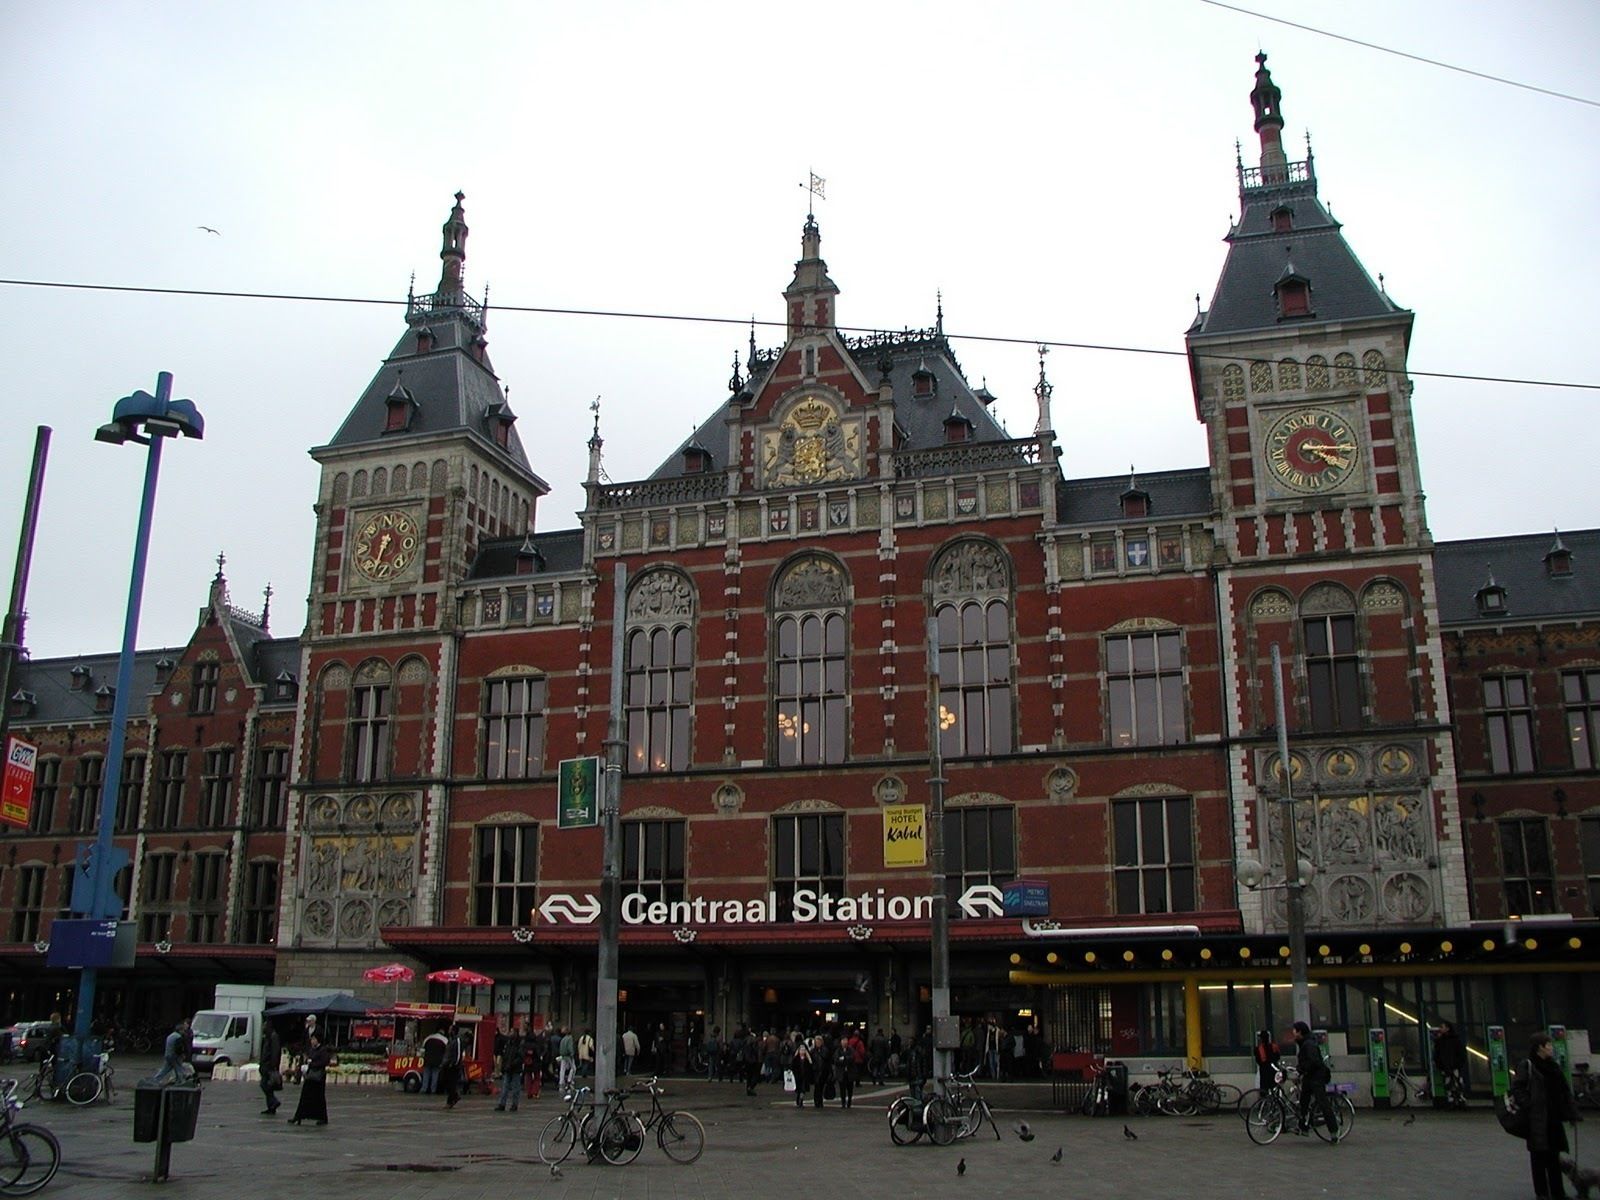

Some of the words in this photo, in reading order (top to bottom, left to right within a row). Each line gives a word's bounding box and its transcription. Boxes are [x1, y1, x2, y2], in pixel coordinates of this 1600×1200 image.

[891, 815, 918, 823] HOTEL
[887, 825, 924, 843] Kabul
[621, 890, 777, 924] Centraal
[792, 888, 933, 922] Station
[394, 1056, 414, 1070] HOT
